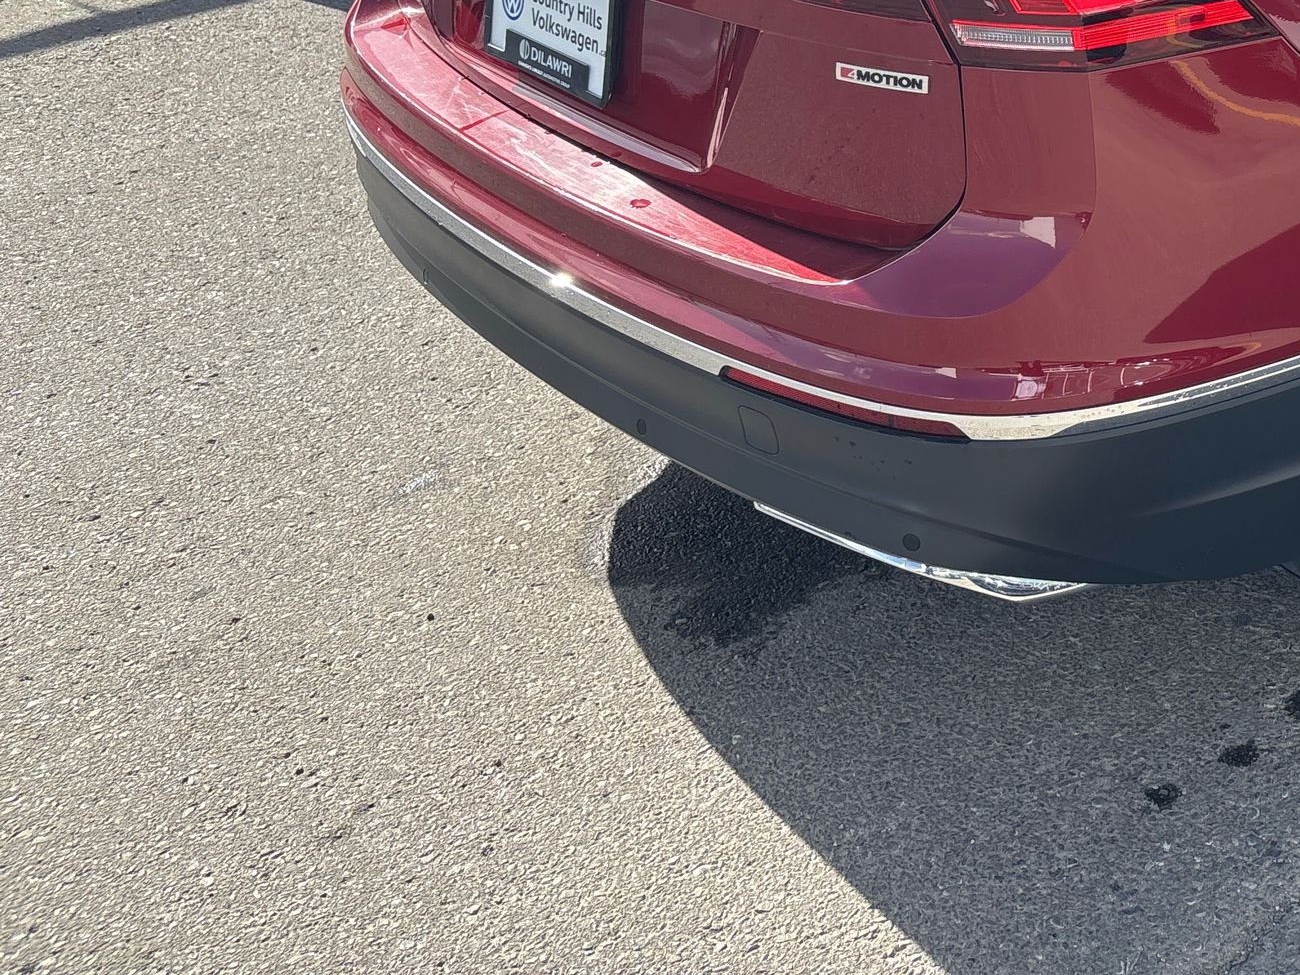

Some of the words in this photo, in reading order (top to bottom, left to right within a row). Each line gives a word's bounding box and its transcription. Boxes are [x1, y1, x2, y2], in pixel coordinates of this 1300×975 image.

[577, 3, 603, 30] Hills
[530, 46, 573, 79] DILAWRI
[840, 66, 923, 90] 4MOTION
